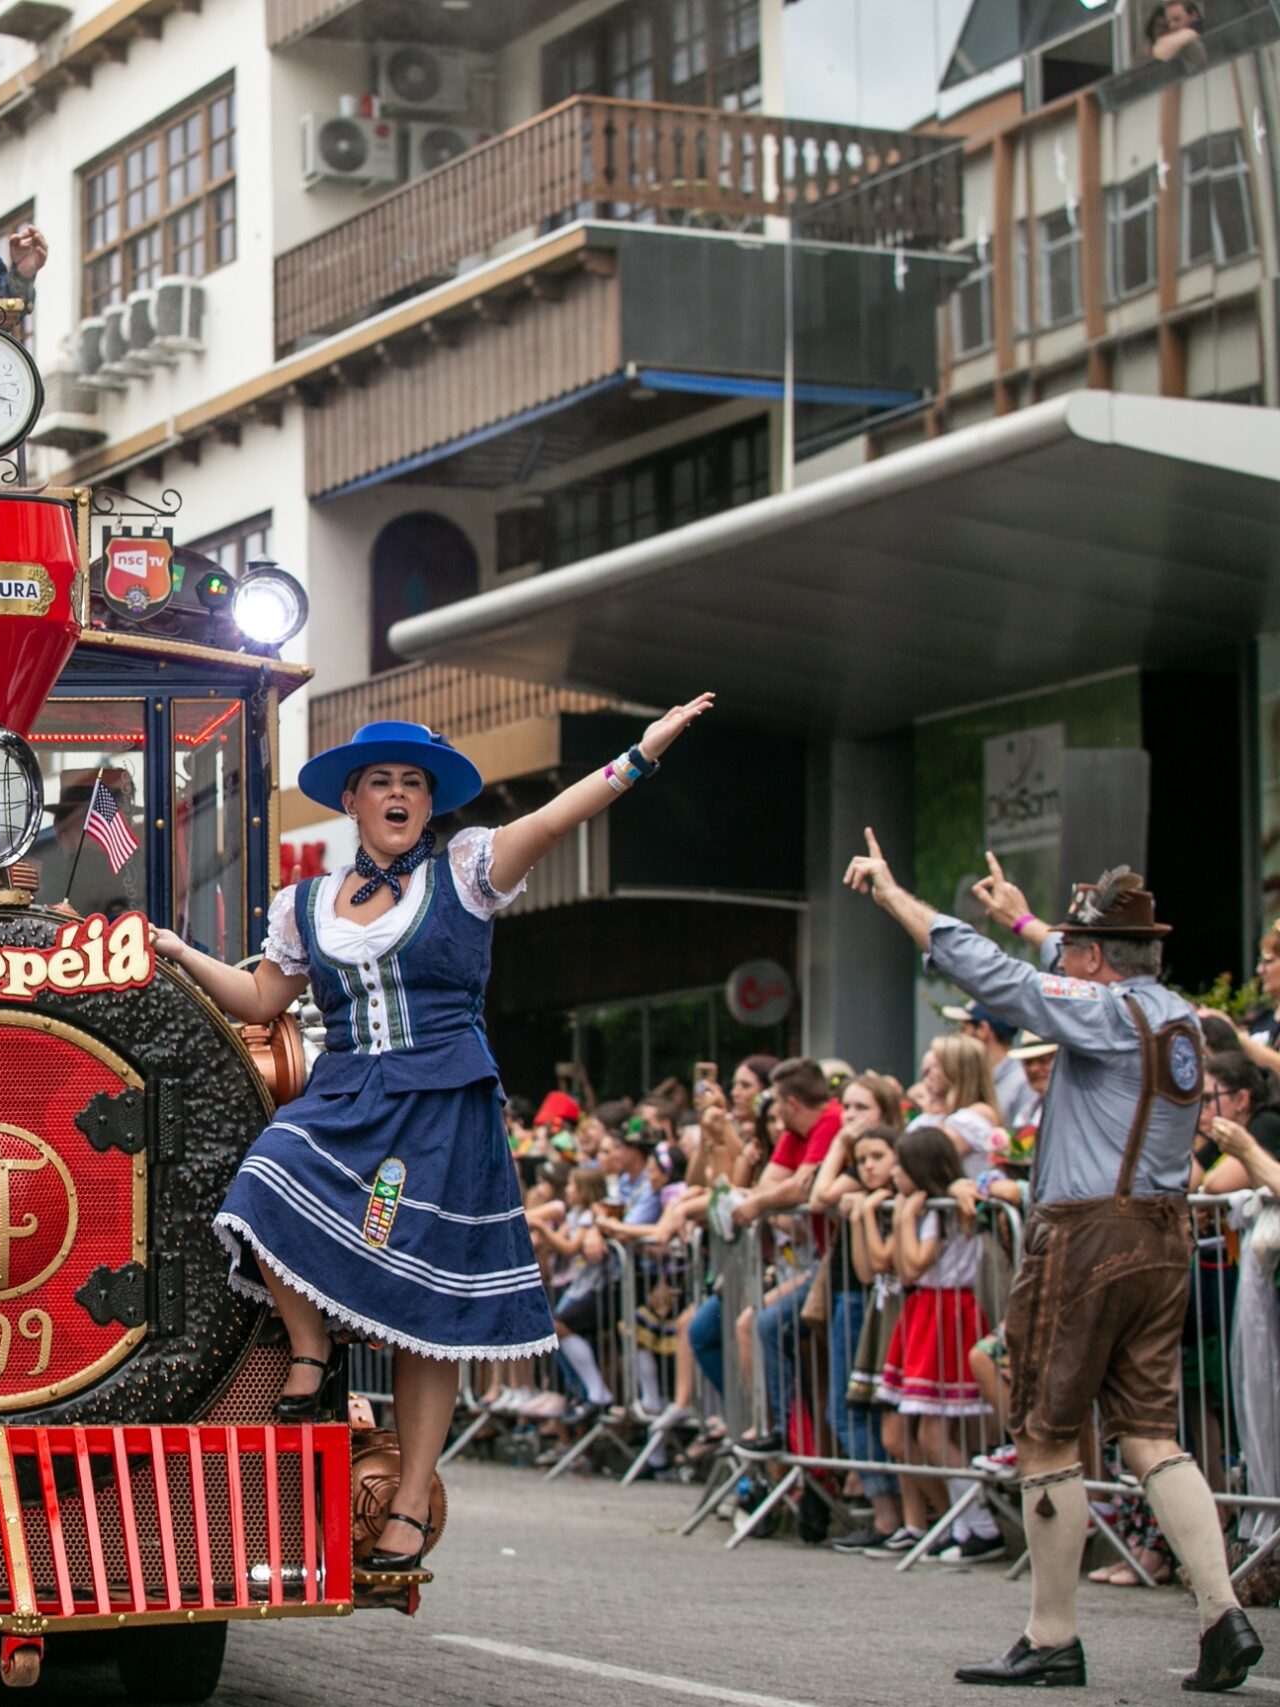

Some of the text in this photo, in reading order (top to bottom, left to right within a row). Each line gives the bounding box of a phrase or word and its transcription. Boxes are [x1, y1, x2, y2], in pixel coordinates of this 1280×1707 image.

[3, 363, 13, 377] 2
[10, 383, 20, 396] 3
[3, 404, 13, 417] 4
[117, 556, 165, 567] nsc TV
